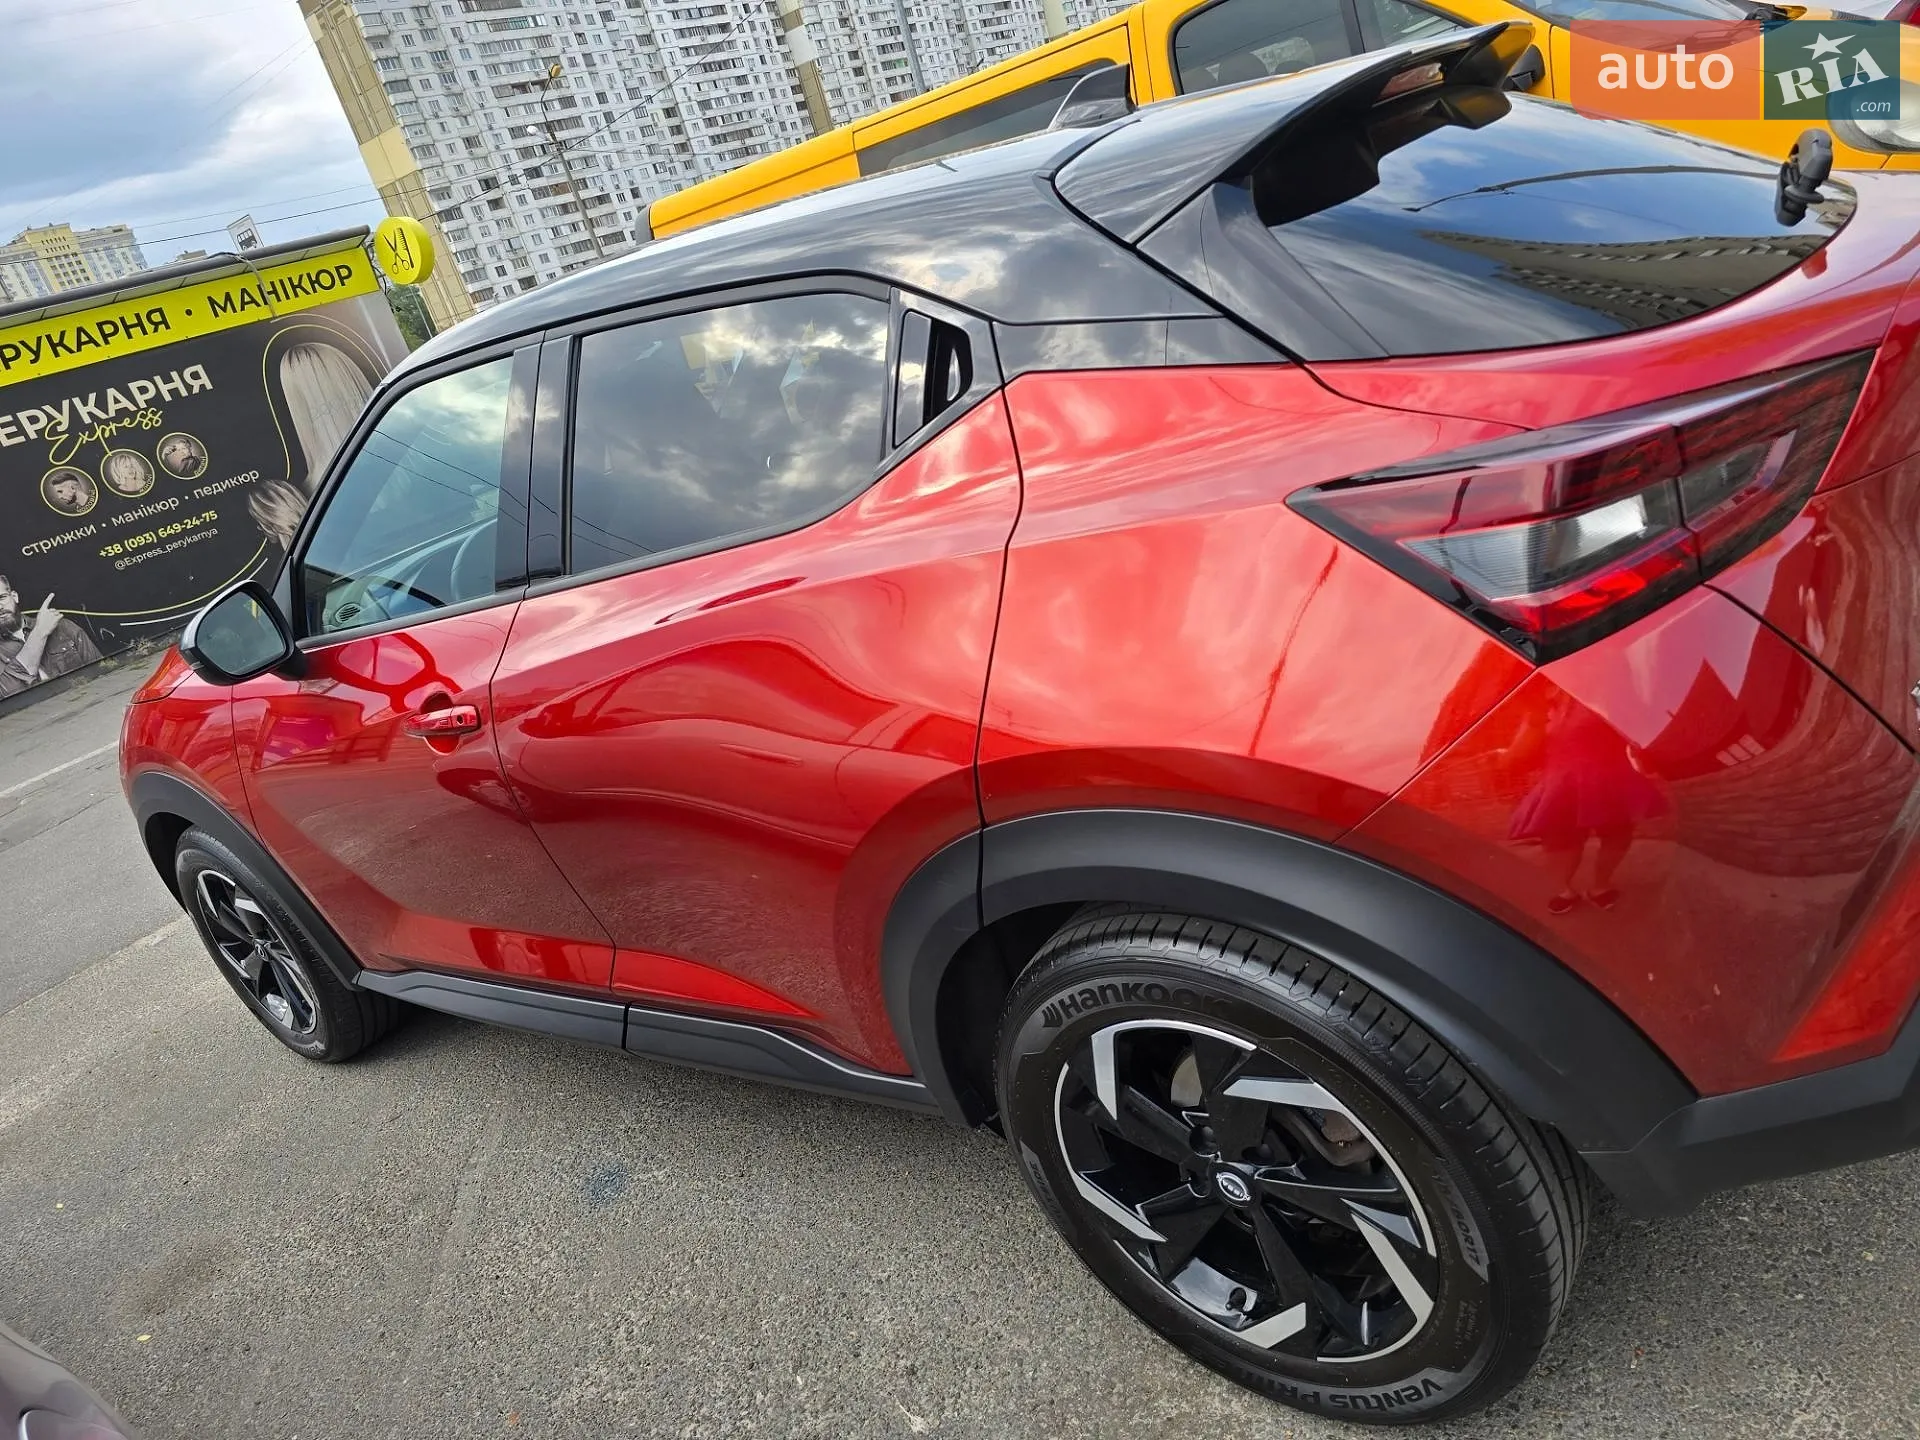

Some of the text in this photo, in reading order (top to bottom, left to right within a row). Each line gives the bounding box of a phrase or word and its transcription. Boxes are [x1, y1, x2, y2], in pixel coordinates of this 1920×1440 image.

[0, 264, 353, 372] РУКАРНЯ МАНІКЮР
[45, 407, 163, 465] Express
[21, 468, 260, 557] стрижки манікюр педикюр
[99, 510, 218, 558] +38 (093) 649-24-75
